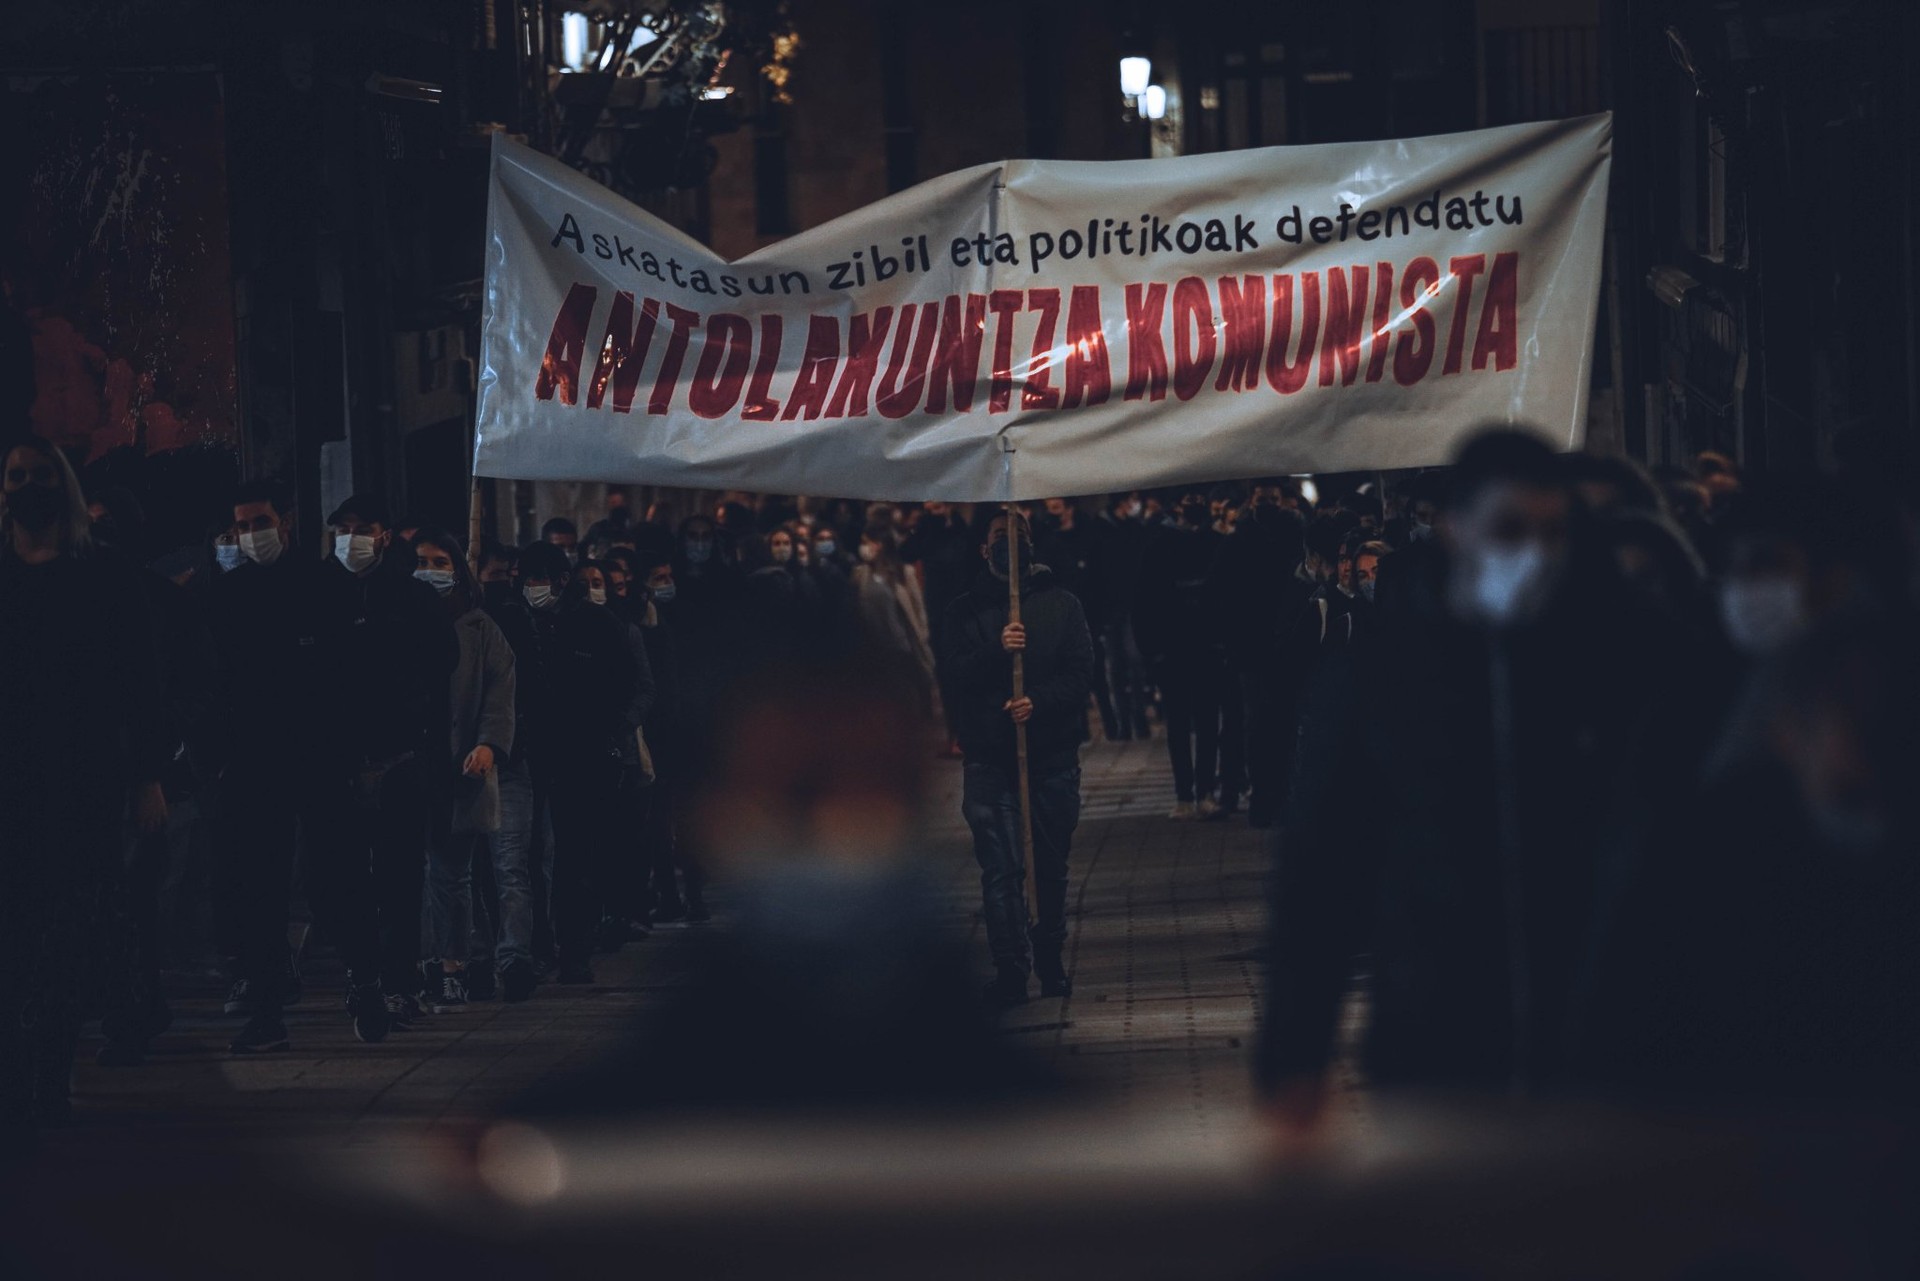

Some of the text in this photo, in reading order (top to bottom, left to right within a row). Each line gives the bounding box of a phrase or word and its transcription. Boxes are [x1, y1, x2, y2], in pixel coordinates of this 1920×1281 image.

[551, 189, 1523, 298] Askatasun zibil eta politikoak defendatu
[535, 281, 1112, 422] ANTOLAKUNTZA
[1123, 251, 1520, 402] KOMUNISTA
